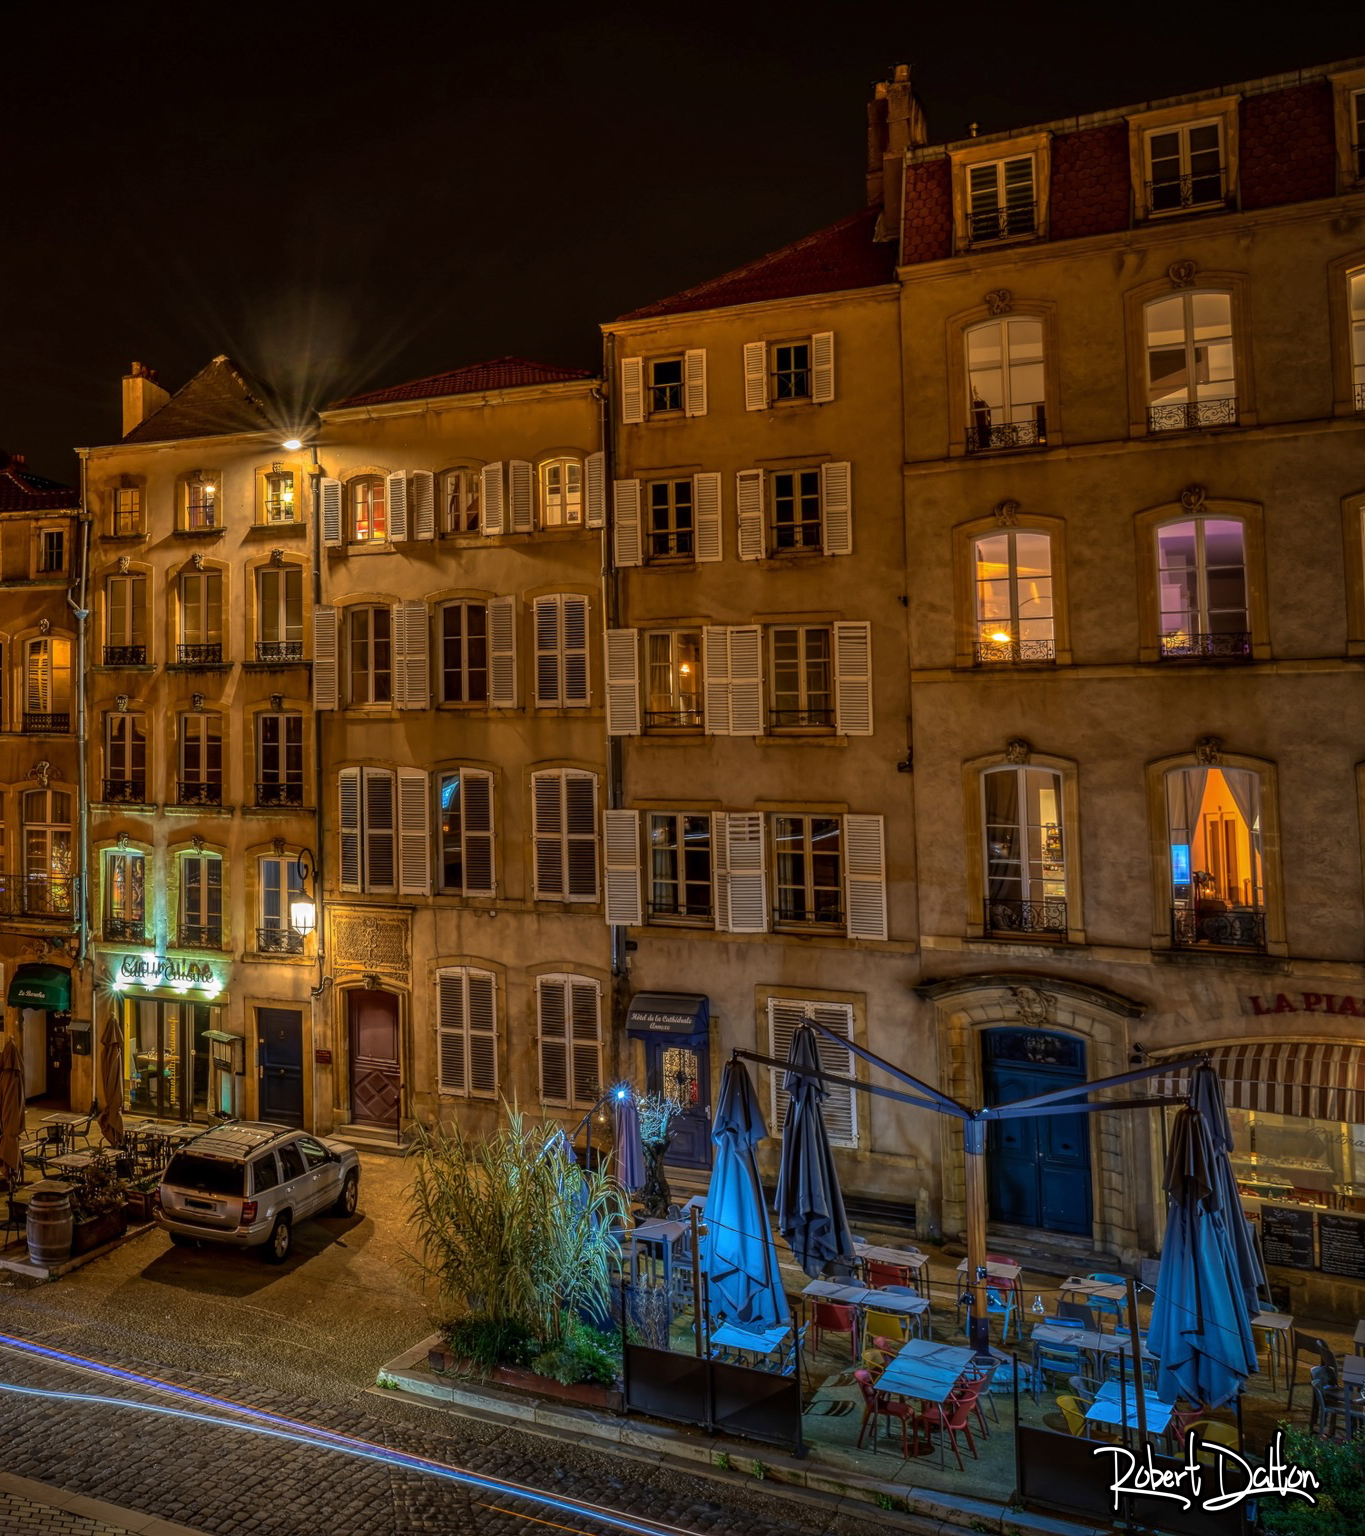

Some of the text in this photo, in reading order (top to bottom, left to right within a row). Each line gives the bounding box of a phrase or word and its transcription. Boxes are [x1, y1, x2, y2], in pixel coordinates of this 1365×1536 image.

[1248, 991, 1365, 1018] LA PIA
[631, 1013, 647, 1021] Hôtel
[655, 1014, 661, 1022] la
[662, 1015, 692, 1024] Cathédrale
[649, 1022, 671, 1031] Annexe
